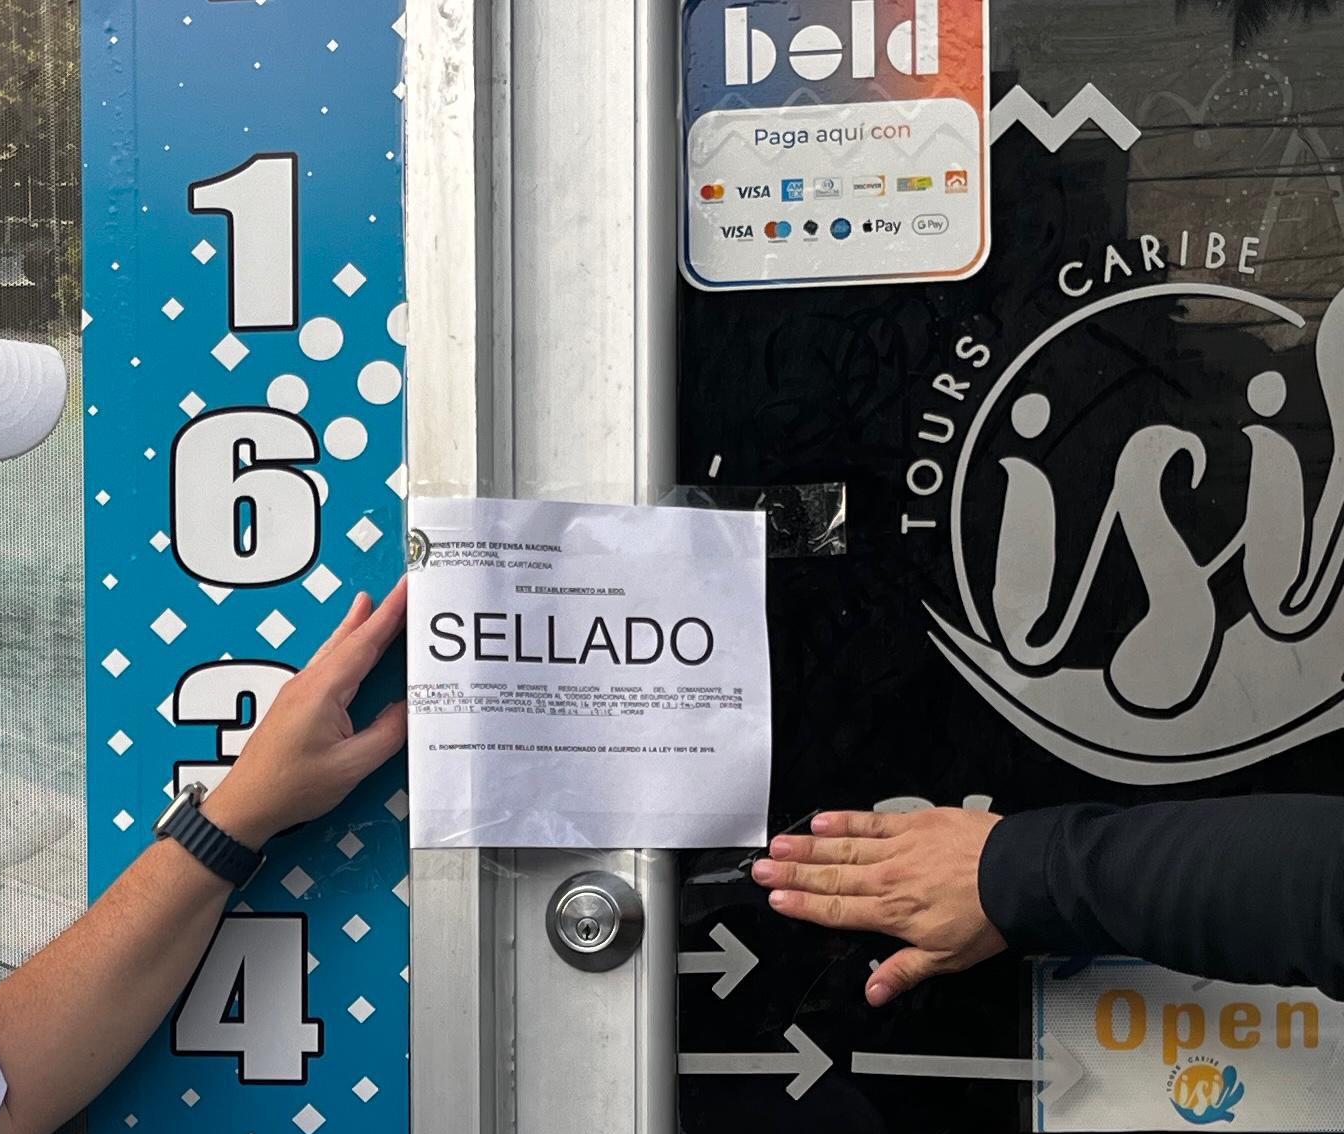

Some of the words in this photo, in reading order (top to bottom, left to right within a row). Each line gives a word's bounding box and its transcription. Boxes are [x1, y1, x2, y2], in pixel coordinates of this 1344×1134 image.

[725, 0, 939, 85] bold
[755, 128, 809, 148] Paga
[816, 122, 864, 145] aquí
[871, 124, 911, 140] con
[736, 186, 771, 199] VISA
[720, 225, 754, 239] VISA
[875, 220, 901, 234] Pay
[928, 218, 944, 231] Pay
[901, 335, 990, 533] TOURS
[1058, 231, 1260, 297] CARIBE
[429, 612, 714, 665] SELLADO
[1096, 989, 1320, 1065] Open
